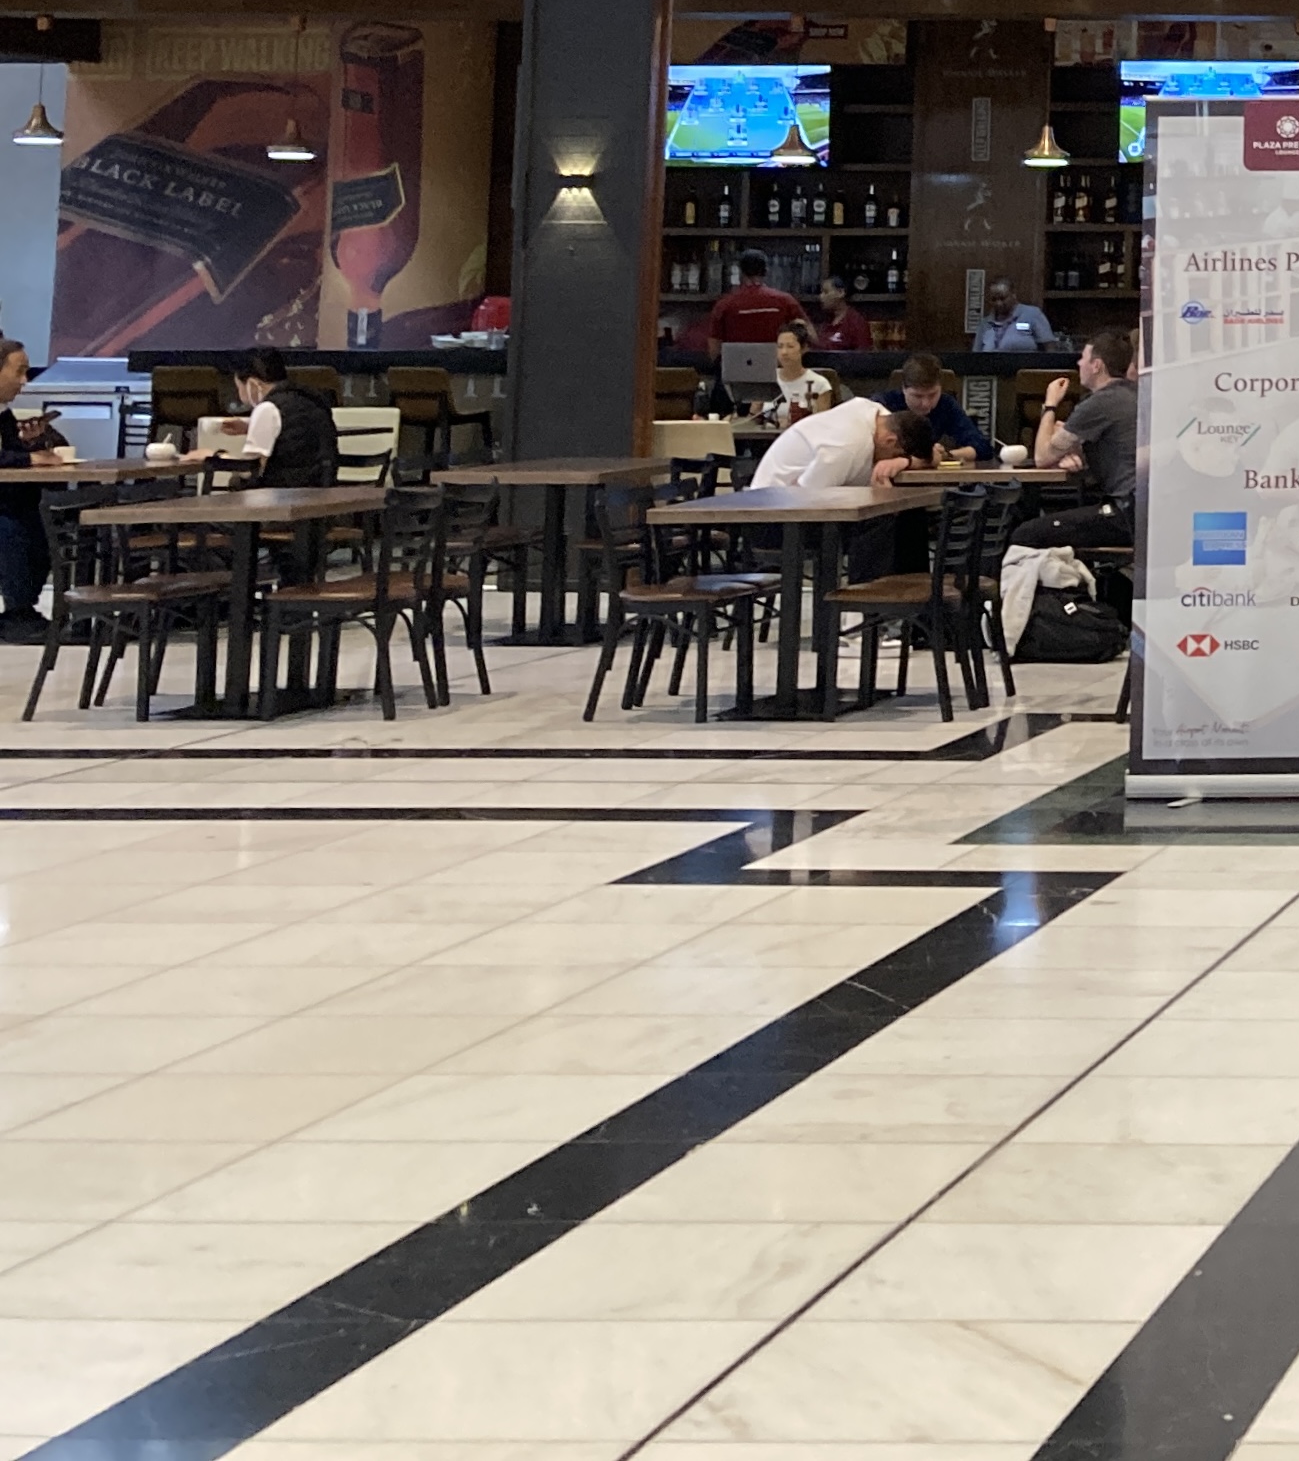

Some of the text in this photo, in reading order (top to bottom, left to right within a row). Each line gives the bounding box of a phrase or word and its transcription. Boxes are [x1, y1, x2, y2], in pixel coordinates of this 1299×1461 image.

[1252, 141, 1281, 149] PLAZA
[163, 181, 244, 218] LABEL
[1184, 251, 1278, 273] Airlines
[1197, 420, 1251, 437] Lounge
[1220, 435, 1239, 443] KEY
[1181, 589, 1257, 607] citibank
[1224, 640, 1260, 651] HSBC
